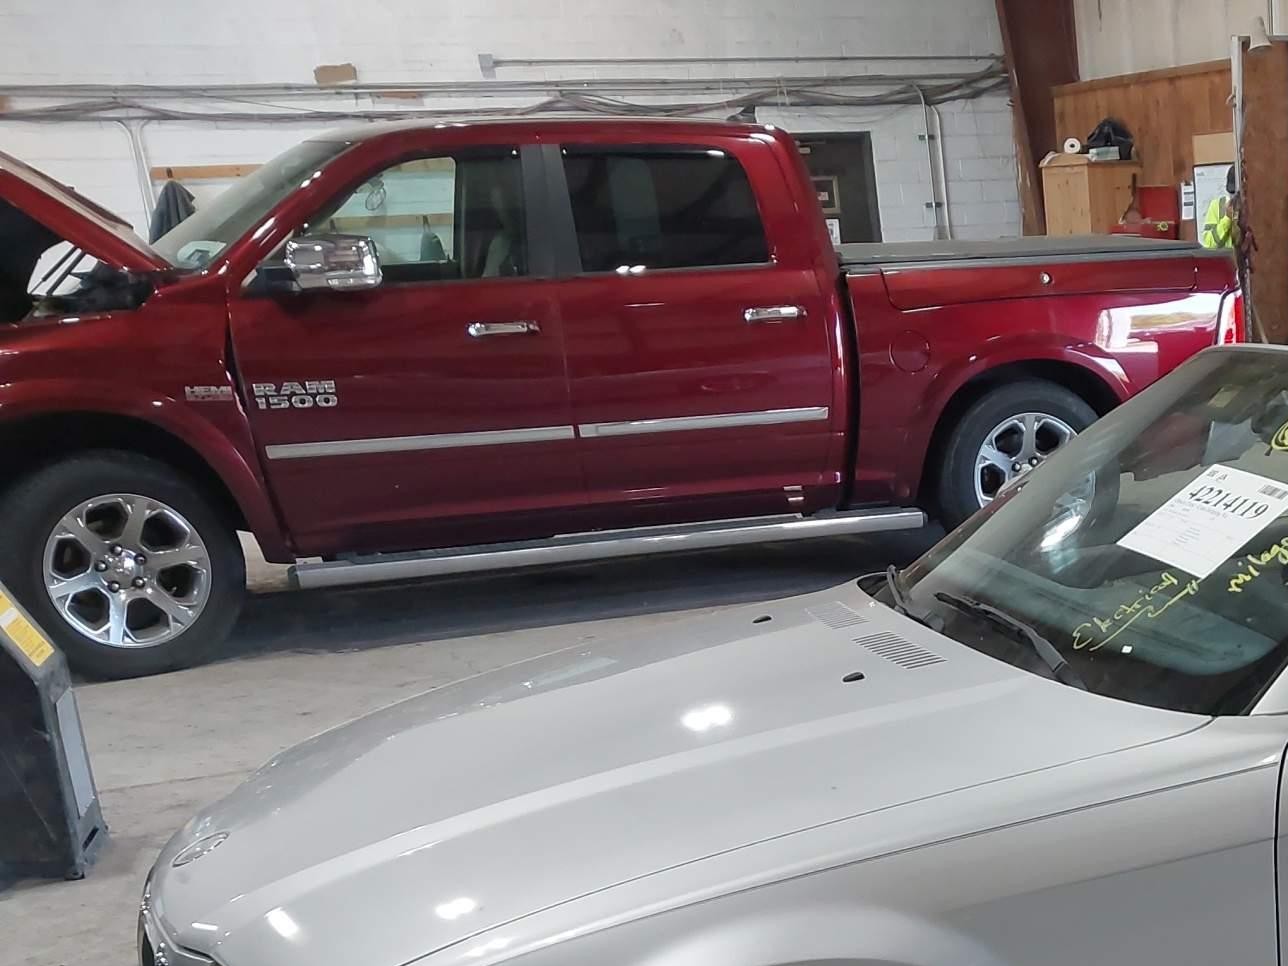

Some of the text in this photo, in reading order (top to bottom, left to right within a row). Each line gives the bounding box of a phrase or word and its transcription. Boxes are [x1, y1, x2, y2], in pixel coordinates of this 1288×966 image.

[185, 386, 232, 395] HEMI
[252, 380, 336, 395] RAM
[255, 395, 338, 409] 1500
[1188, 484, 1270, 520] 42214119
